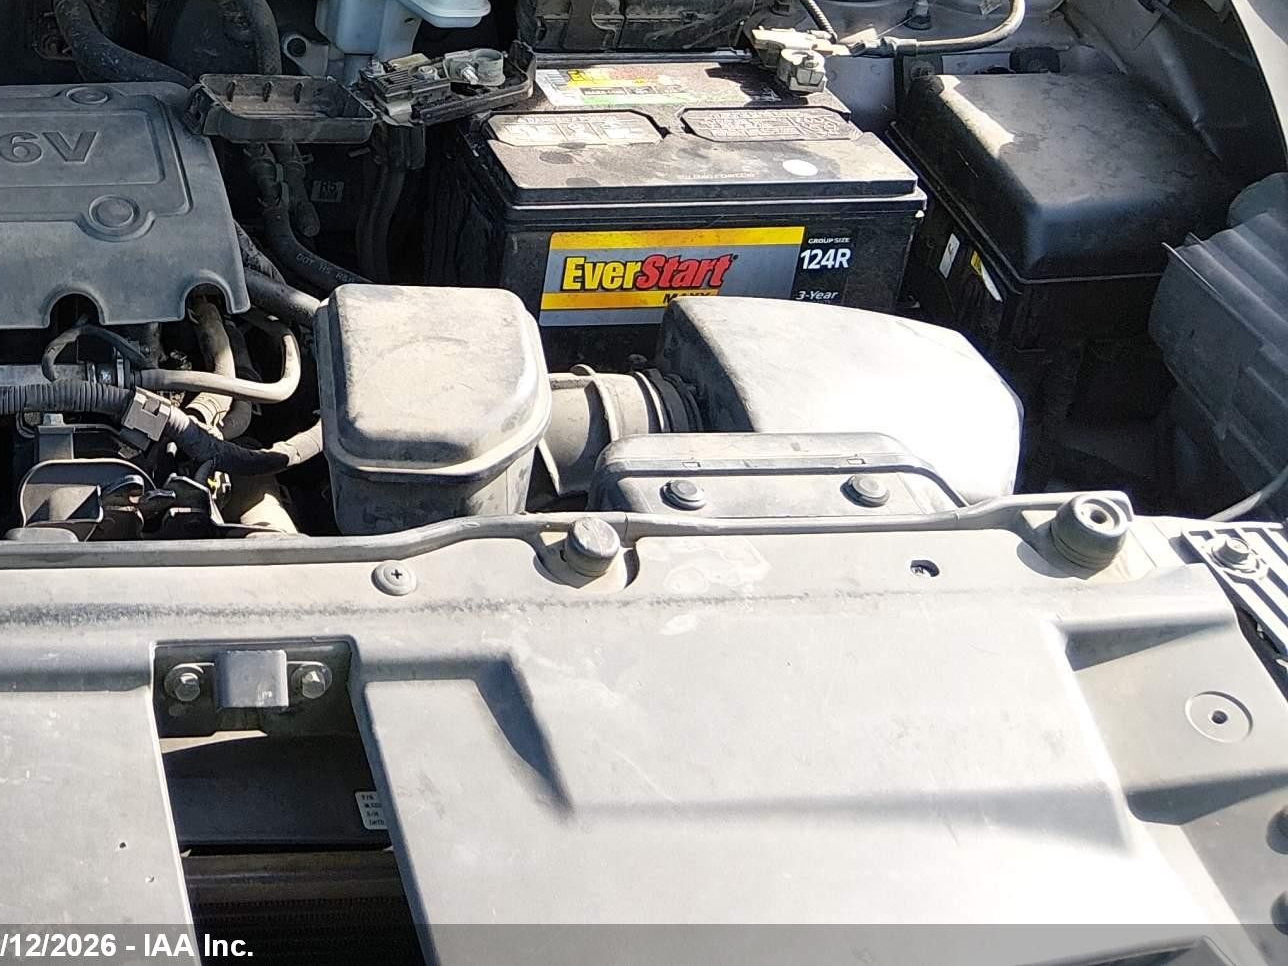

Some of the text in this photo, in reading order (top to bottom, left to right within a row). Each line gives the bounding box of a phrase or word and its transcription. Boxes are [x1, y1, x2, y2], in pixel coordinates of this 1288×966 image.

[807, 236, 833, 244] GROUP
[800, 248, 851, 270] 124R
[561, 253, 735, 291] EverStart
[796, 290, 840, 300] 3-Year
